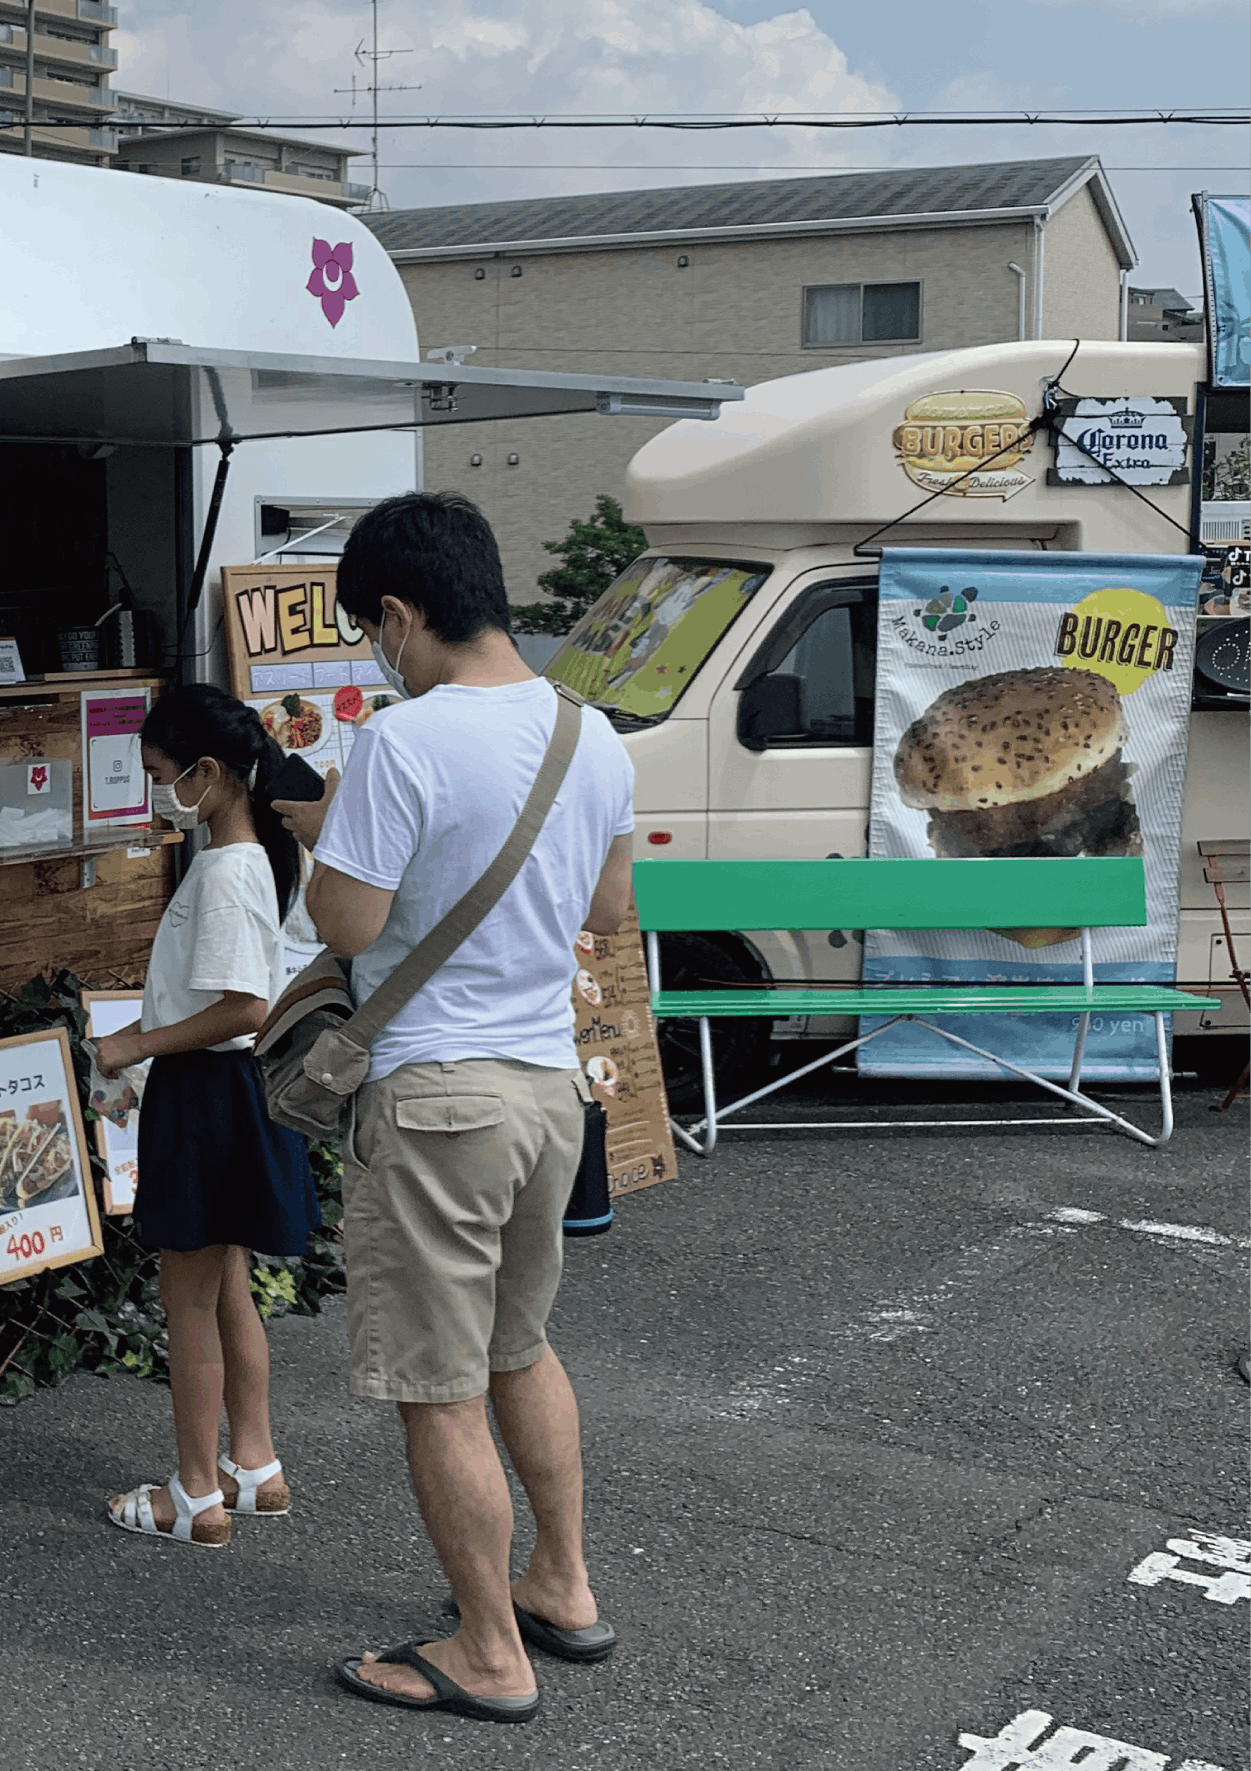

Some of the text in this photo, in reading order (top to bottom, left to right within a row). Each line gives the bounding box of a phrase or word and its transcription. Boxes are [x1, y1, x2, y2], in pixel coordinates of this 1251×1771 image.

[902, 422, 1034, 460] BURGERS
[1078, 427, 1169, 458] Corona
[1100, 452, 1151, 469] Extra
[1053, 612, 1179, 672] BURGER
[1109, 1018, 1144, 1036] yen
[6, 1225, 64, 1261] 400 円
